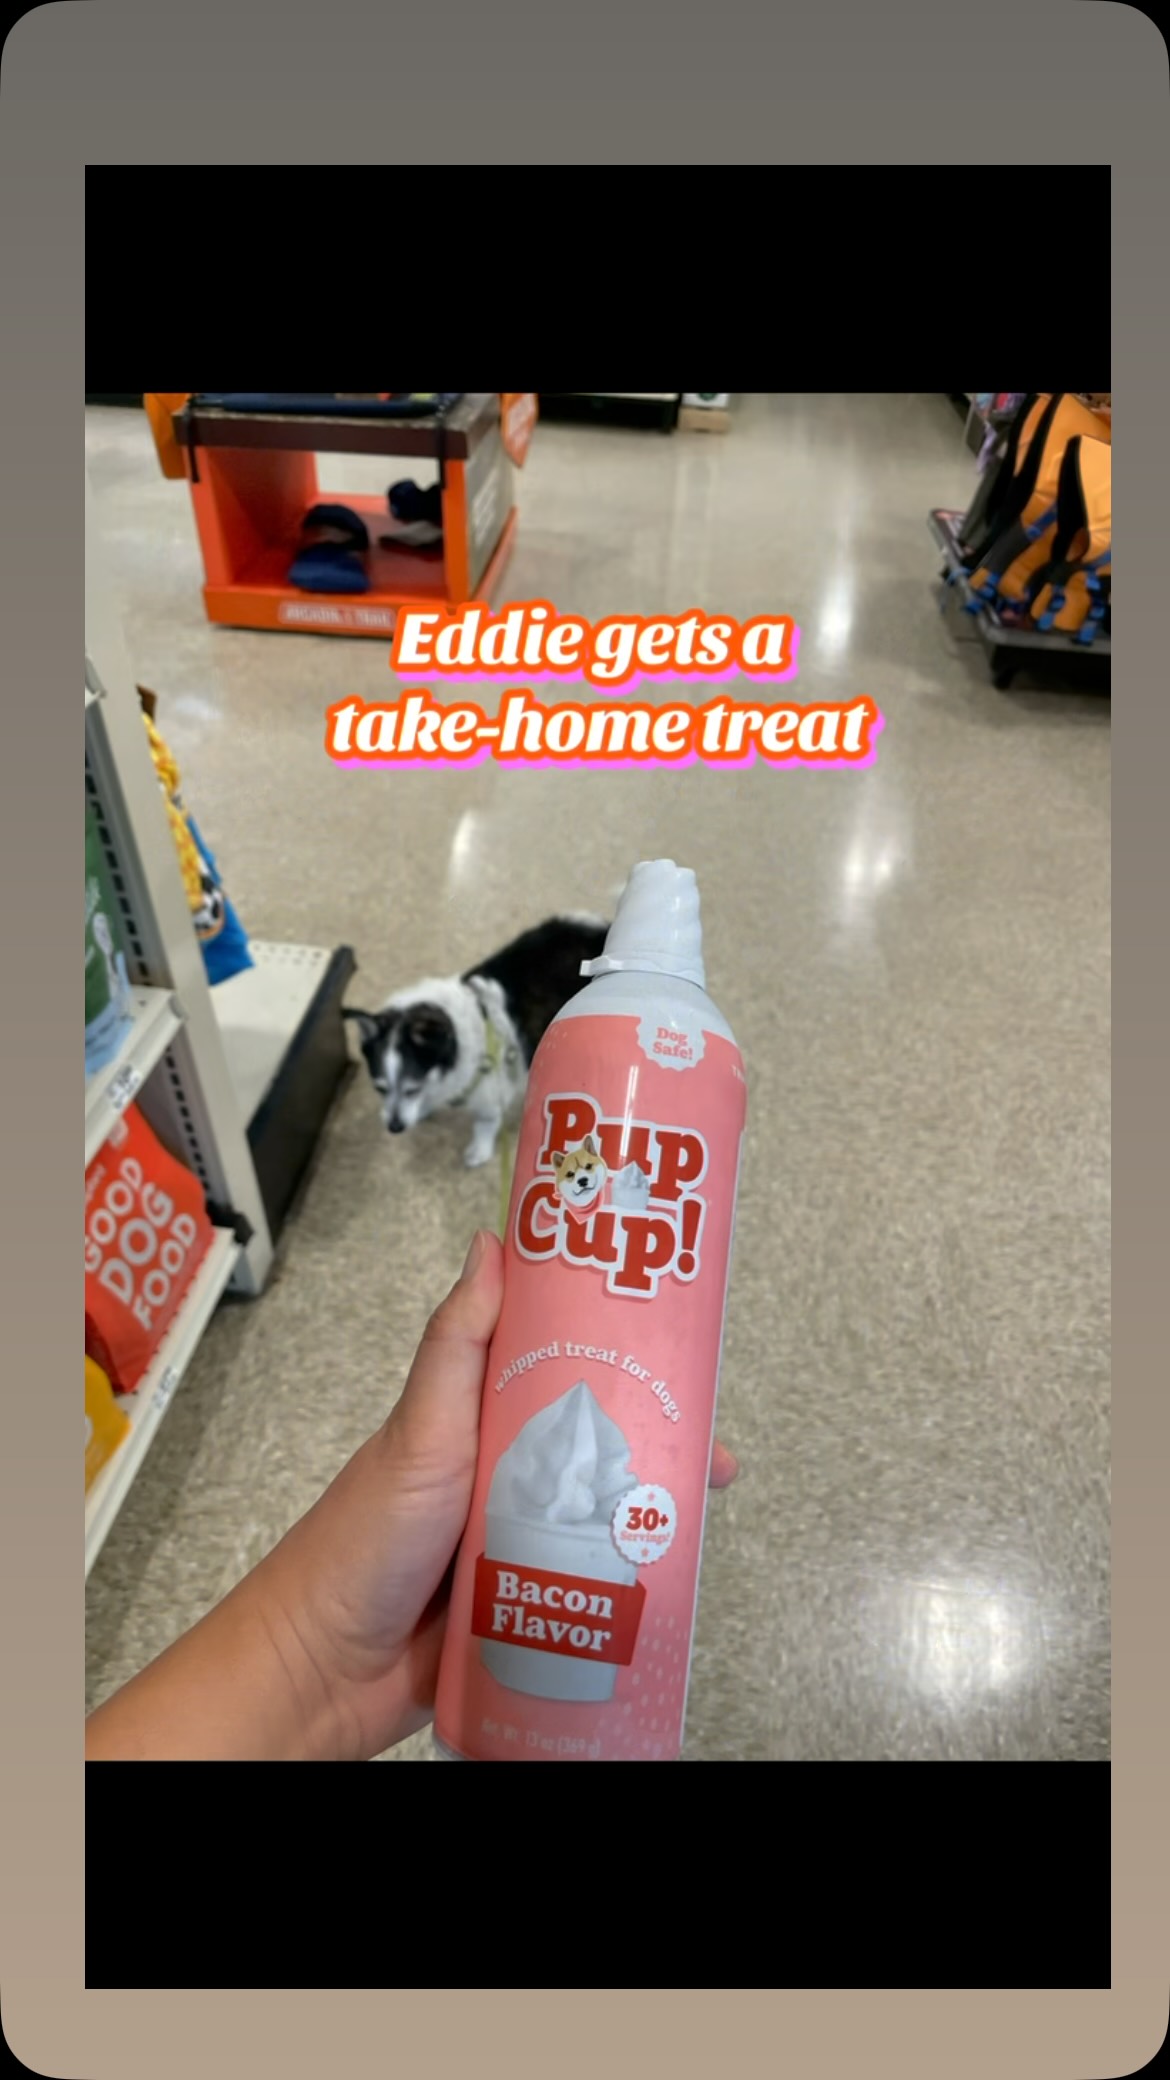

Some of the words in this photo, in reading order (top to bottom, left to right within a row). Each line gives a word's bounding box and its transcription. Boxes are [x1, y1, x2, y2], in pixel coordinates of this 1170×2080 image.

[653, 1041, 693, 1060] Safe!
[656, 1027, 688, 1047] Dog
[540, 1097, 705, 1202] Pup
[85, 1157, 143, 1273] GOOD
[99, 1182, 174, 1304] DOG
[518, 1182, 703, 1291] Cup!
[132, 1213, 197, 1331] FOOD
[494, 1341, 561, 1394] whipped
[565, 1341, 619, 1366] treat
[620, 1355, 651, 1383] for
[651, 1379, 682, 1424] dogs
[626, 1506, 669, 1531] 30+
[492, 1603, 612, 1652] Flavor
[496, 1570, 614, 1619] Bacon
